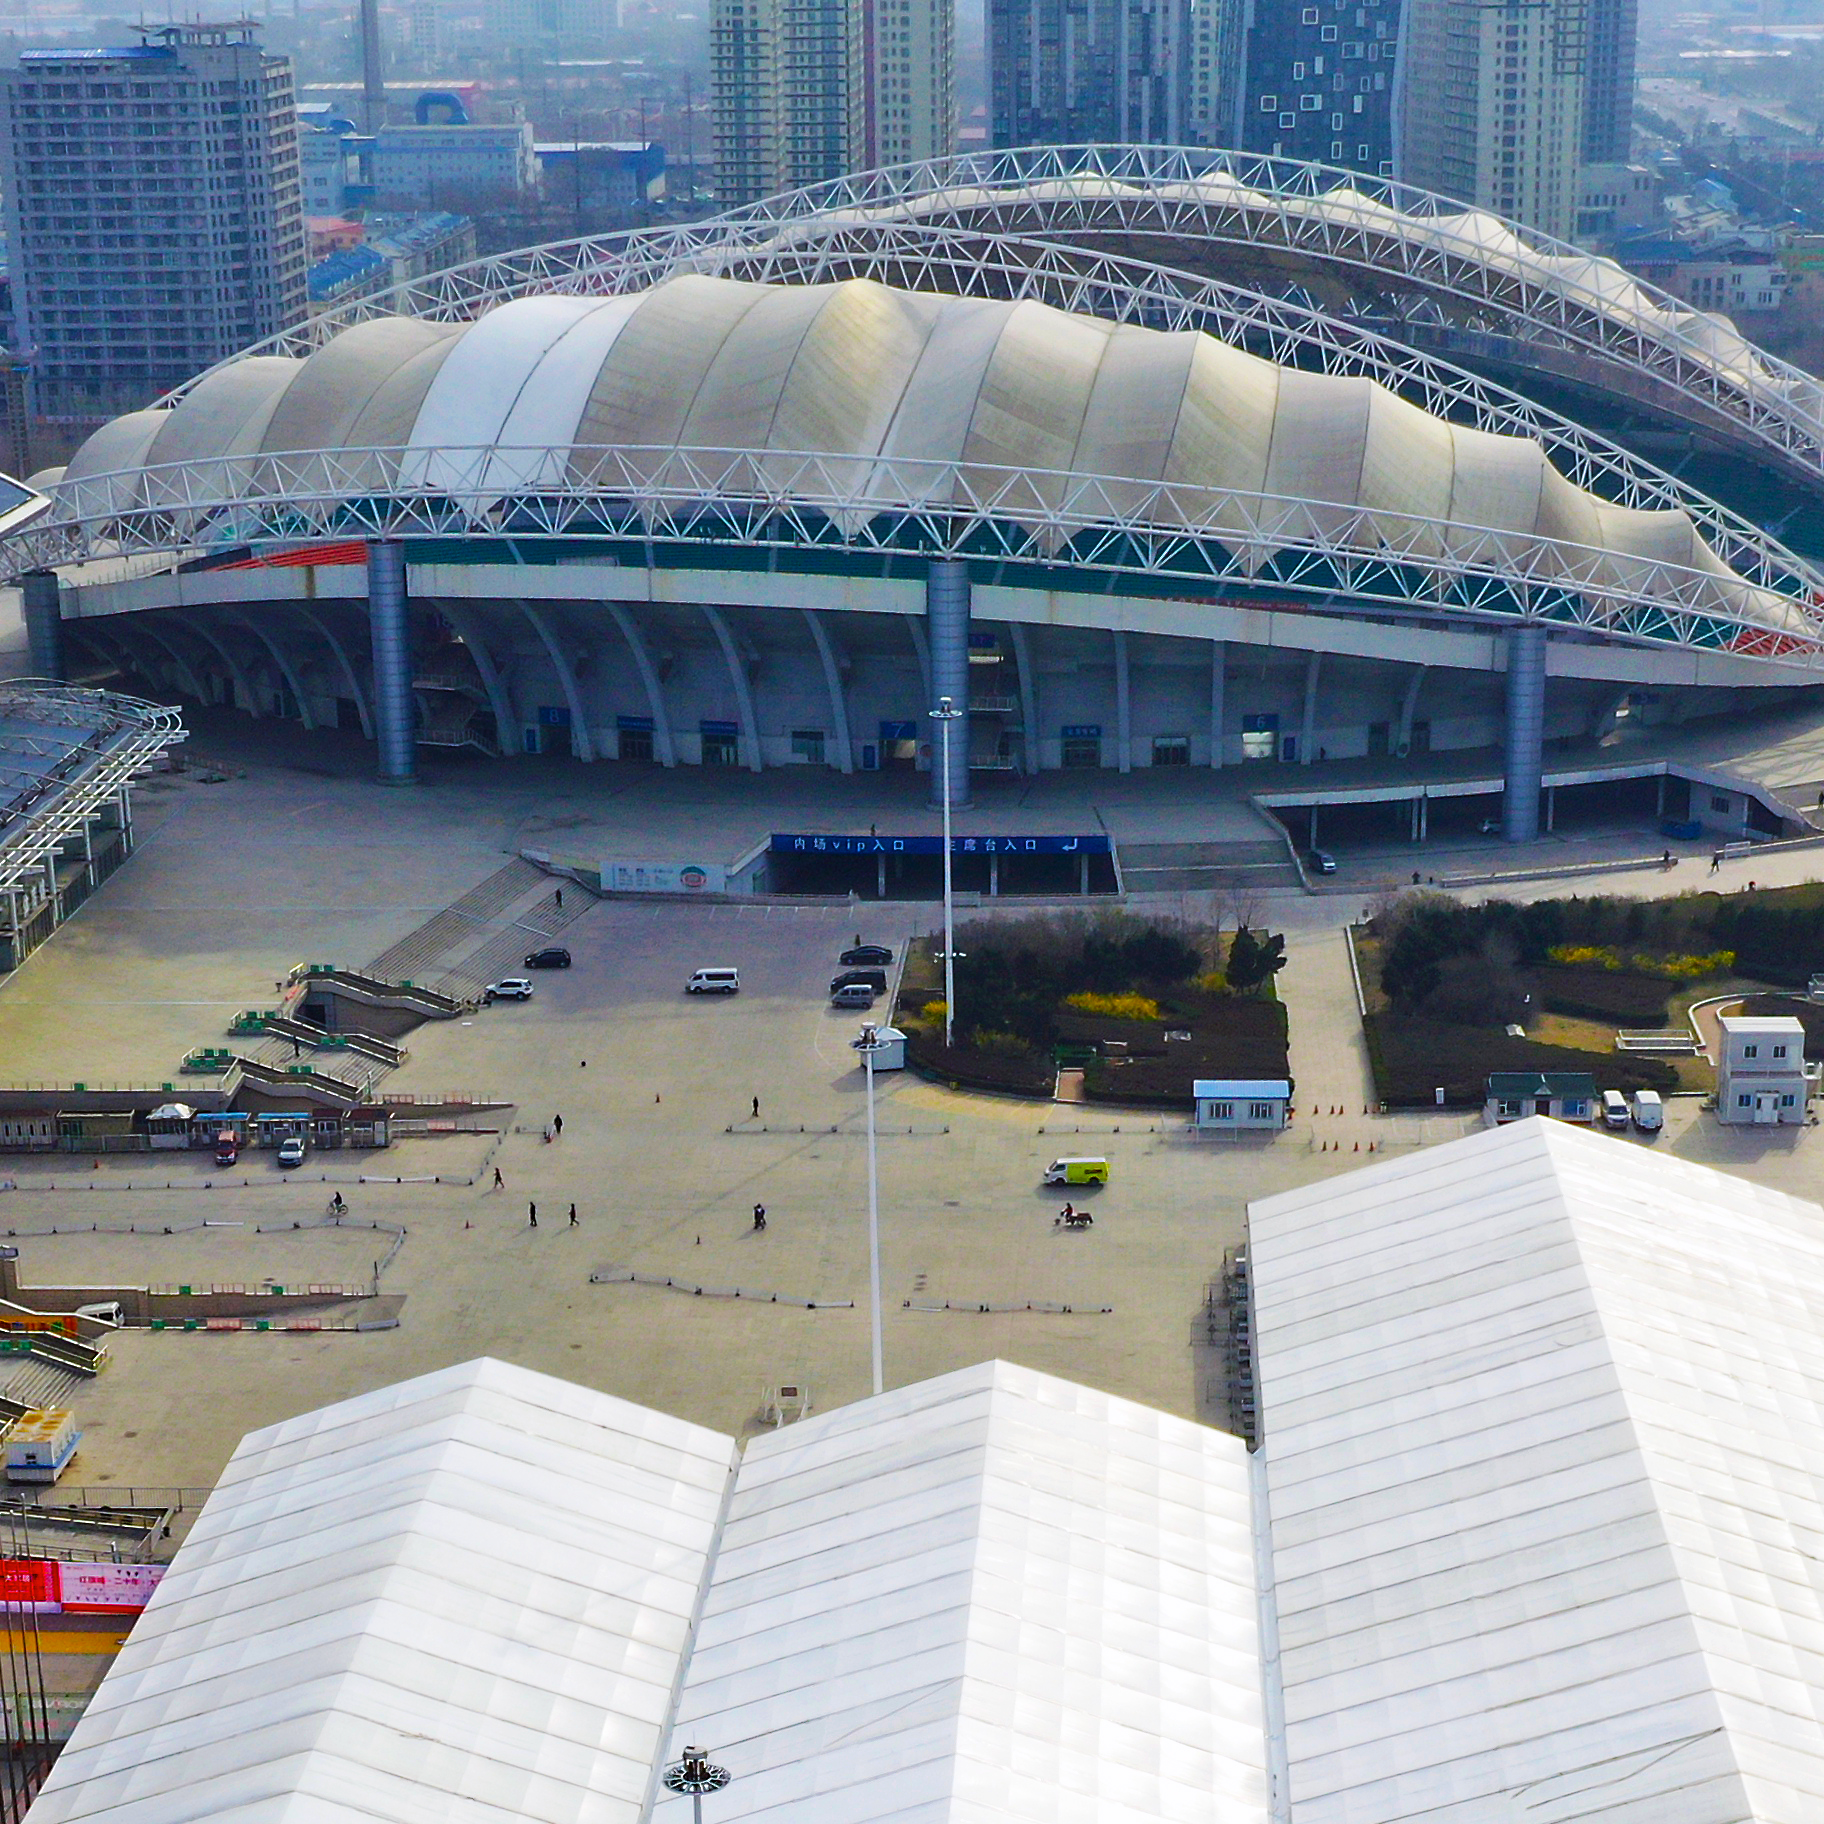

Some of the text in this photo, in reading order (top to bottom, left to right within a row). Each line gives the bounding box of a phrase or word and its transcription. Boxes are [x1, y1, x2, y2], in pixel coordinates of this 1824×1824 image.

[549, 708, 560, 723] 8
[1256, 716, 1265, 729] 6
[891, 723, 905, 738] 7
[794, 838, 905, 852] 内场vip入口
